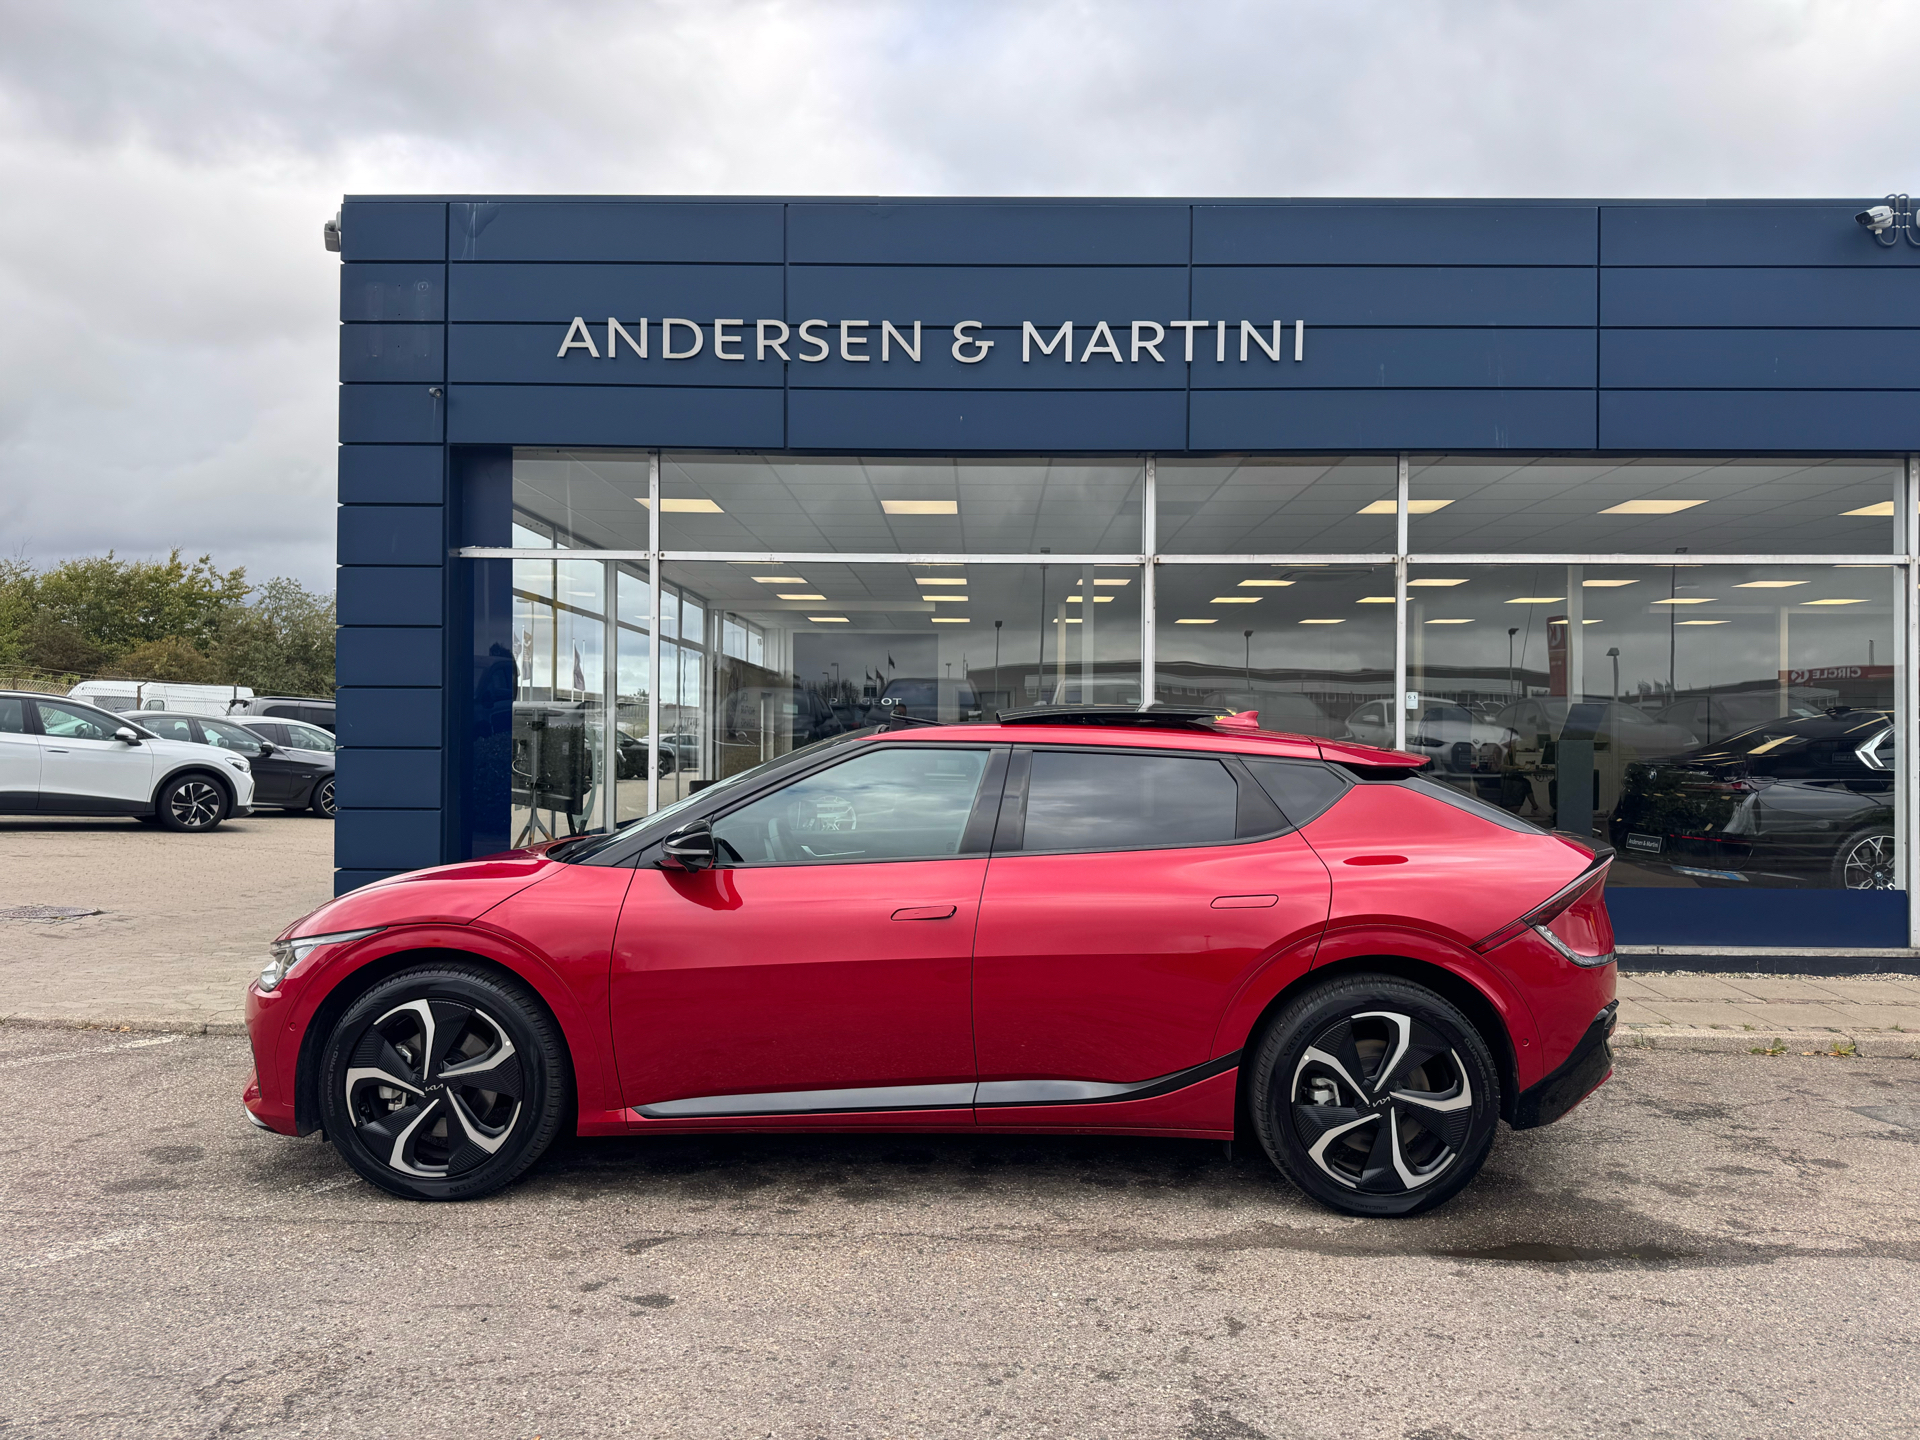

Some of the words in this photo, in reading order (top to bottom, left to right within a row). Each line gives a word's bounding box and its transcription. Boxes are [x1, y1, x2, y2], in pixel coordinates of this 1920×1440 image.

[556, 316, 922, 363] ANDERSEN
[951, 320, 995, 364] &
[1021, 319, 1305, 364] MARTINI
[829, 697, 902, 706] PEUGEOT
[1283, 1011, 1328, 1056] VREDESTEIN
[1463, 1037, 1487, 1080] QUATRAC
[1482, 1080, 1491, 1101] PRO
